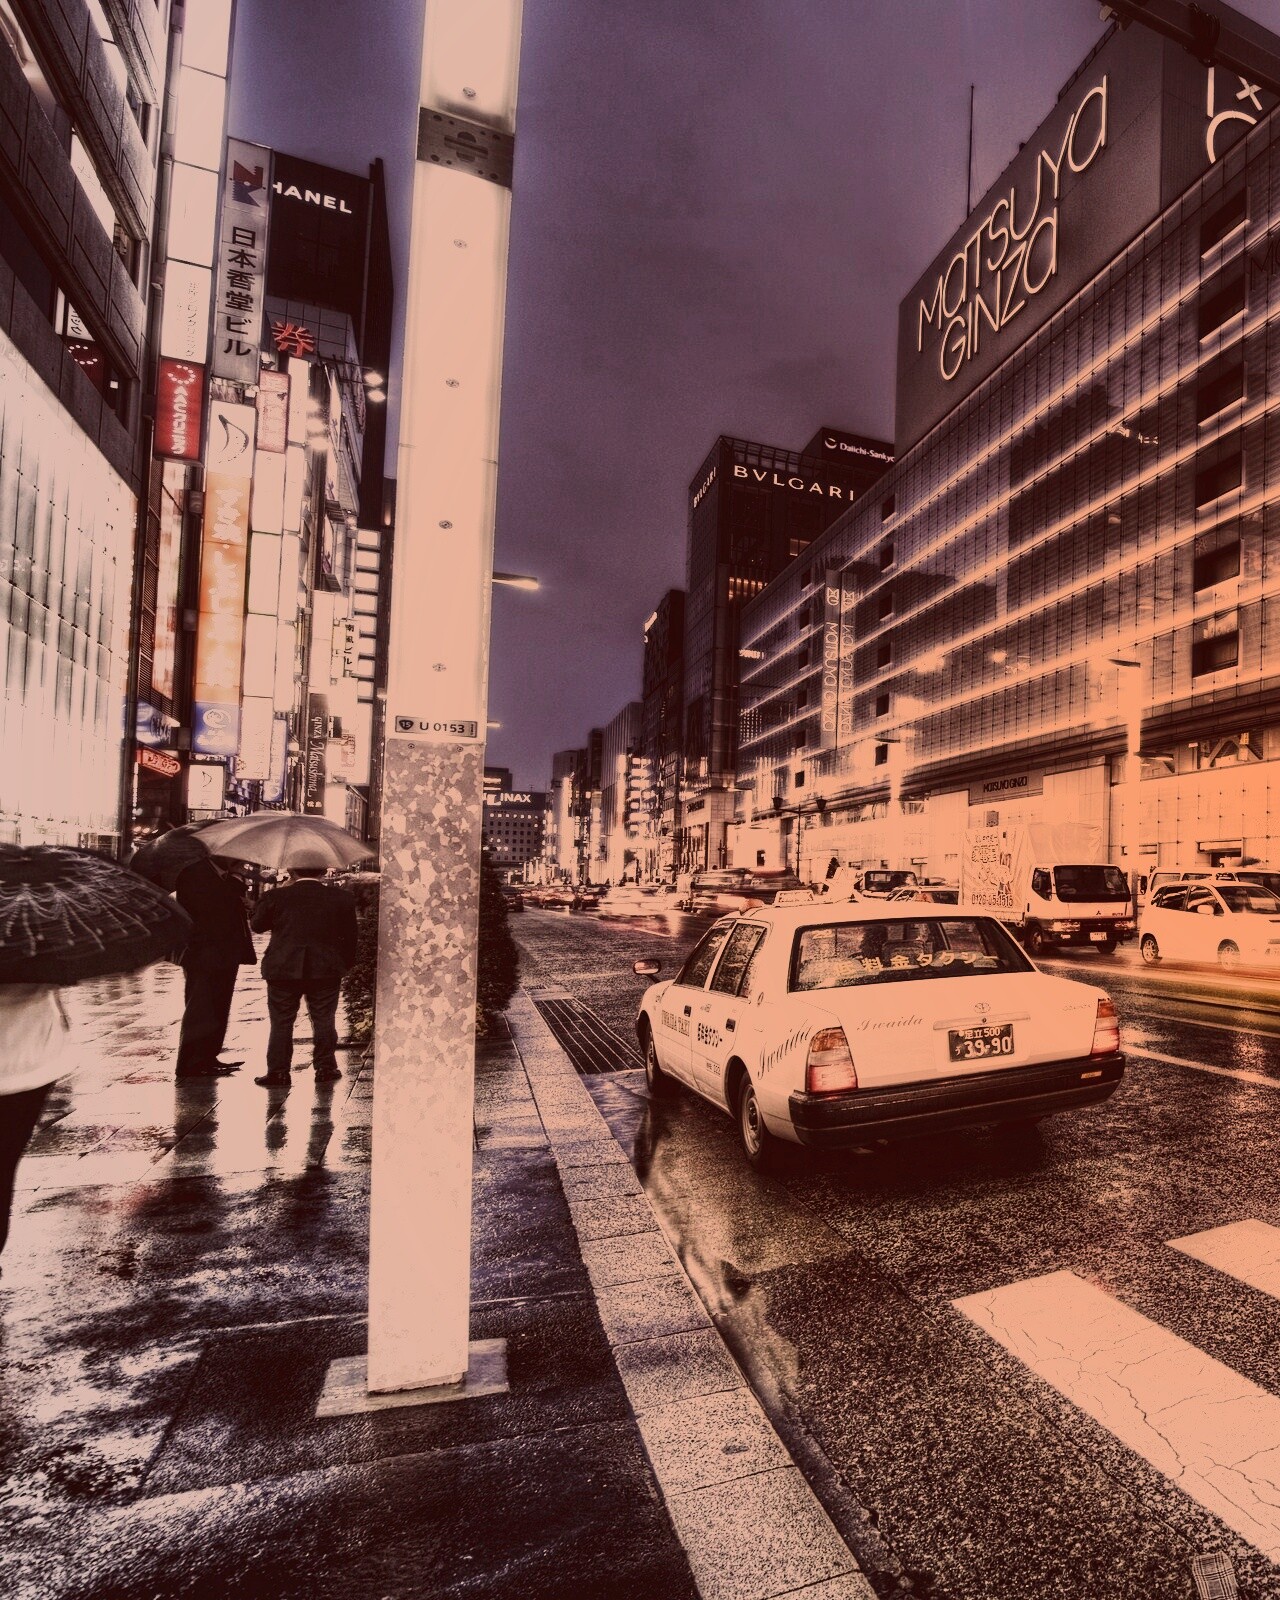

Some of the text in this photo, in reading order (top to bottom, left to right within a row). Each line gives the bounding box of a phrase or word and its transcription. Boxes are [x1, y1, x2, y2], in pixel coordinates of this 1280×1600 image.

[272, 181, 353, 214] HANEL
[223, 226, 257, 357] 日本香堂ビル
[733, 465, 854, 501] BVLGARI
[419, 721, 429, 731] U
[433, 722, 465, 734] 0153
[499, 792, 531, 803] INAX
[834, 951, 999, 977] 低料金タクシー
[857, 1014, 924, 1031] Iwaida
[983, 1027, 1001, 1038] 500
[964, 1036, 1012, 1058] 39-90
